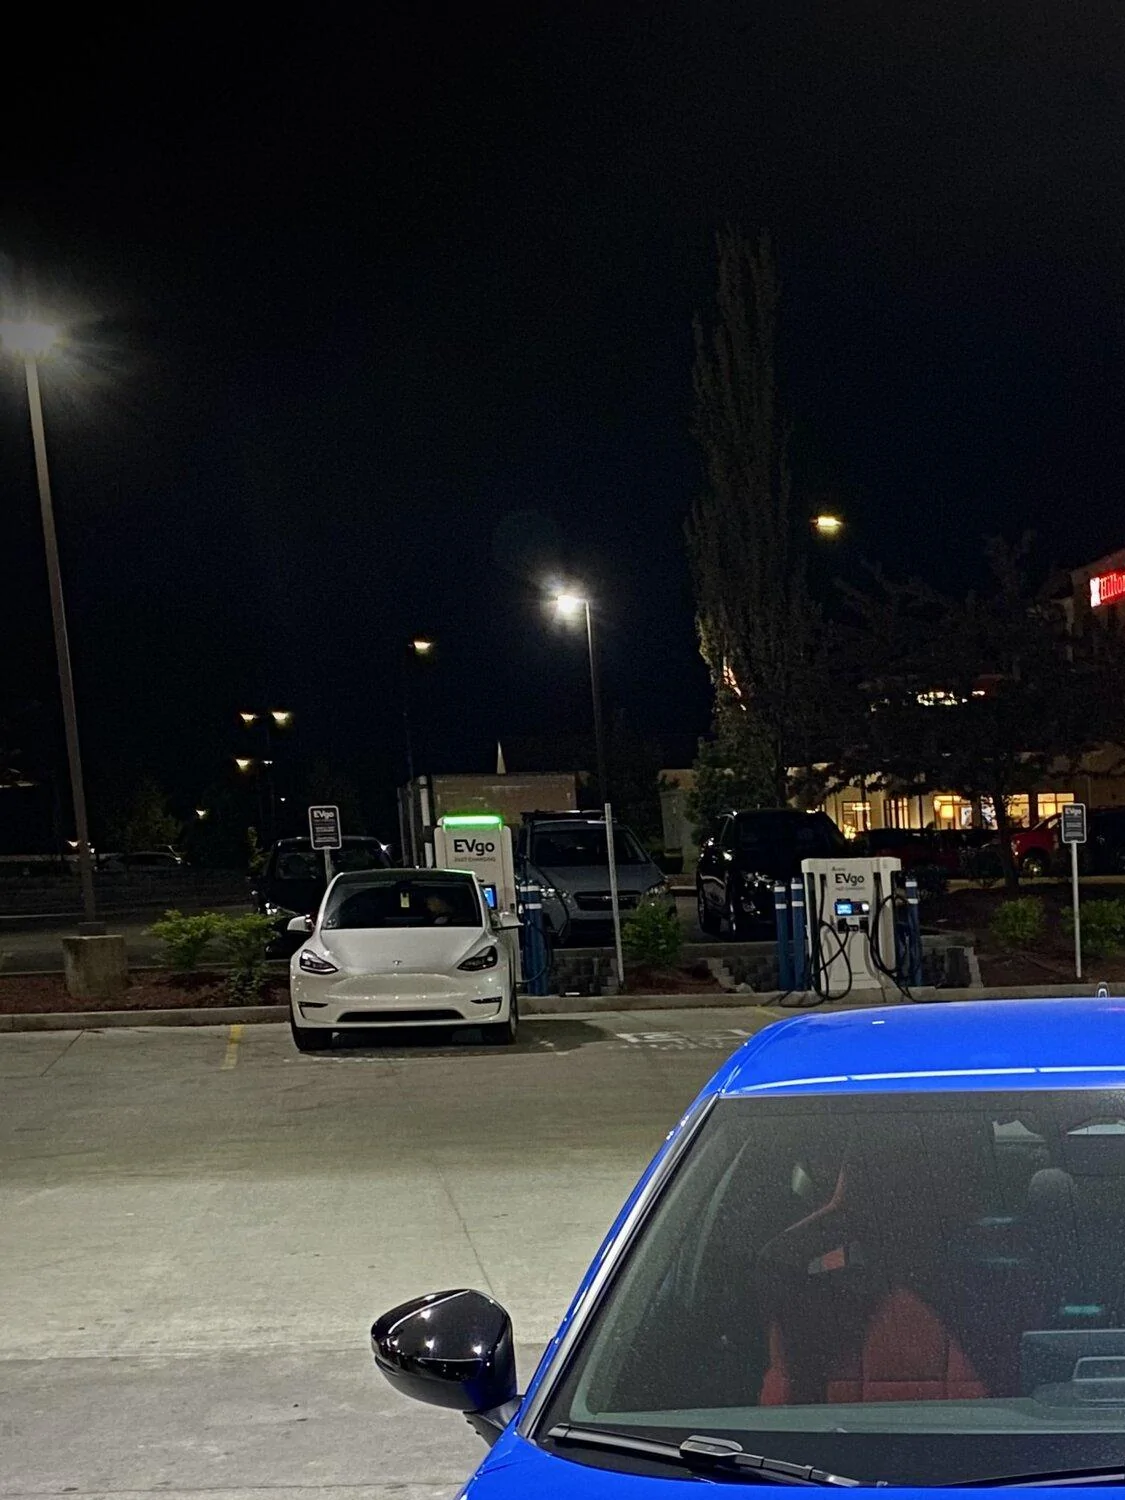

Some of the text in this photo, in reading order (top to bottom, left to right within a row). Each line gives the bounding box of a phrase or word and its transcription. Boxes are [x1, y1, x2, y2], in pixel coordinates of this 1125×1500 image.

[313, 810, 335, 819] EVgo
[453, 839, 495, 856] EVgo
[834, 873, 865, 886] EVgo
